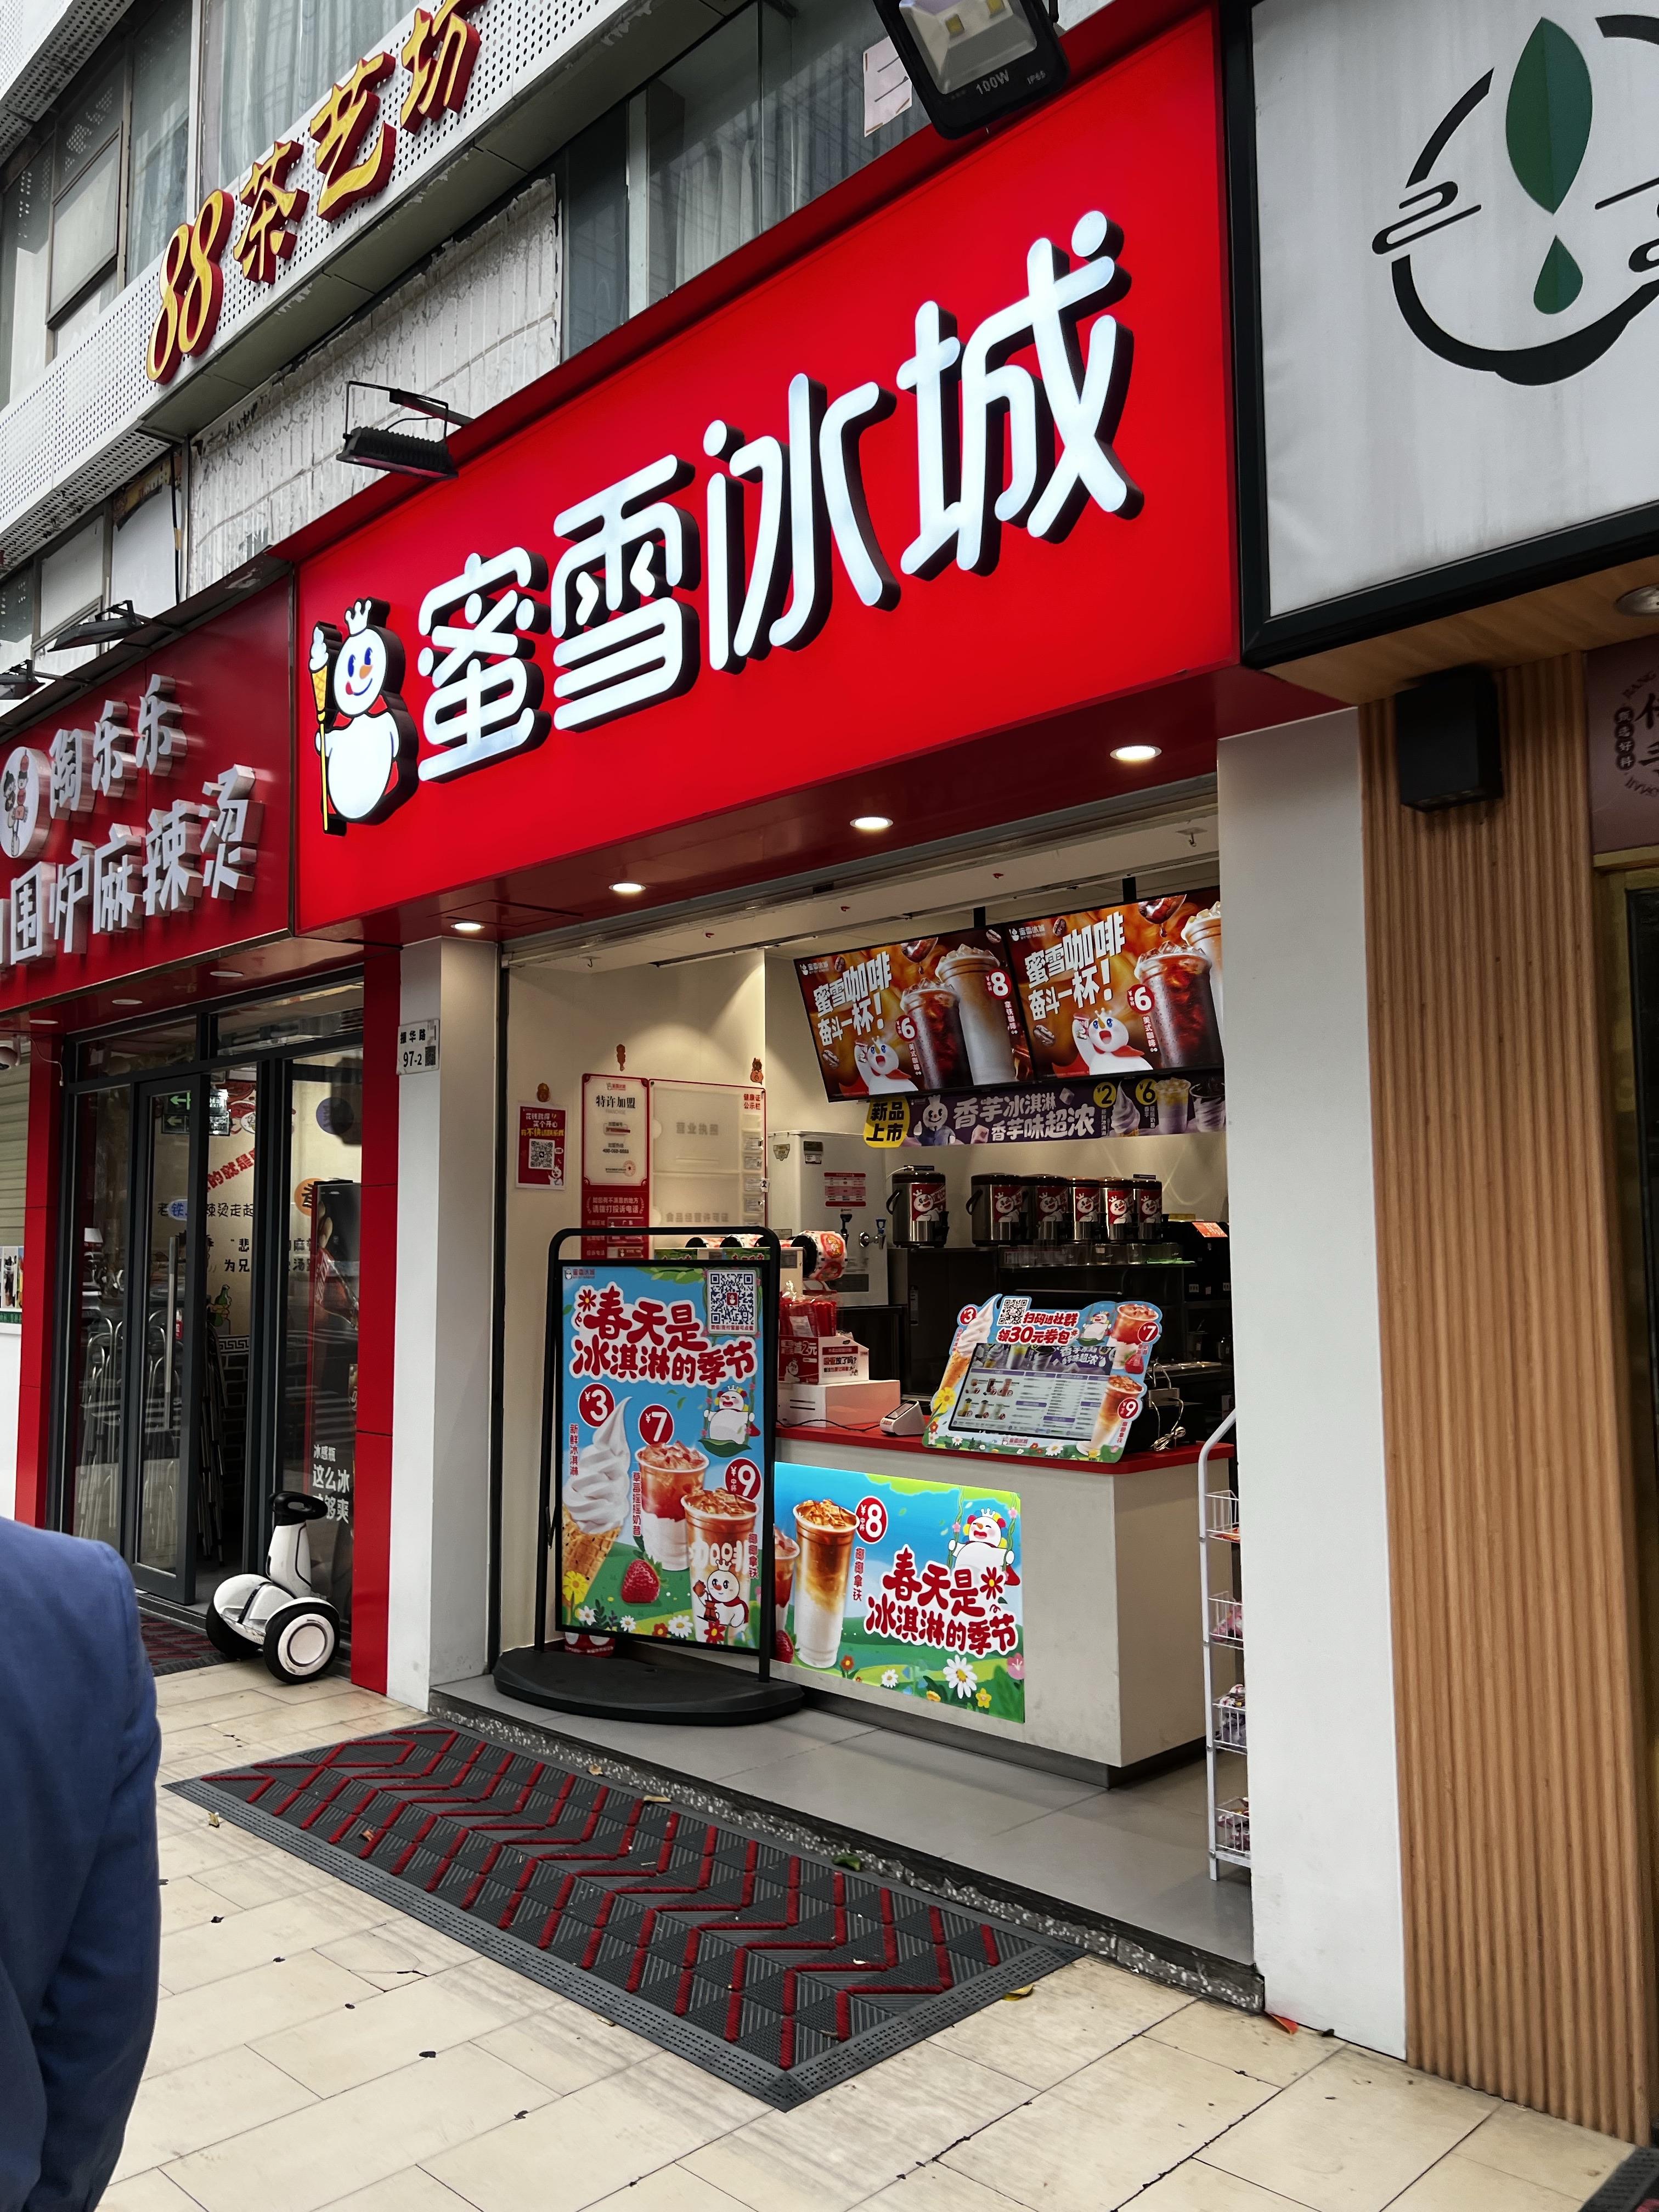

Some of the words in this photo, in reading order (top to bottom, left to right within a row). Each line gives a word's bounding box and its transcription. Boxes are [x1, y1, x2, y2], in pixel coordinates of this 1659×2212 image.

[976, 70, 1009, 94] 100W
[418, 211, 1143, 783] 蜜雪冰城
[0, 764, 263, 968] 围炉麻辣烫
[1025, 912, 1125, 989] 蜜雪咖啡
[814, 951, 891, 1017] 蜜雪咖啡
[1028, 959, 1113, 1021] 奋斗一杯！
[817, 993, 884, 1046] 奋斗一杯！
[404, 1051, 422, 1067] 97-2
[596, 1095, 635, 1108] 特许加盟
[744, 1093, 761, 1102] 健康证
[871, 1101, 904, 1121] 新品
[953, 1093, 1056, 1129] 香芋冰淇淋
[676, 1122, 719, 1136] 营业执照
[866, 1123, 903, 1142] 上市
[991, 1104, 1094, 1141] 香芋味超浓
[207, 1148, 255, 1192] 的就是
[583, 1285, 708, 1352] 春天是
[573, 1334, 755, 1385] 冰淇淋的季节
[585, 1389, 608, 1421] ¥3
[645, 1412, 667, 1442] ¥7
[313, 1444, 336, 1462] 冰感瓶
[569, 1424, 579, 1475] 新鲜冰淇淋
[312, 1464, 350, 1493] 这么冰
[731, 1464, 756, 1497] ¥9
[313, 1493, 349, 1524] 够爽
[861, 1504, 883, 1538] ¥8
[883, 1548, 985, 1617] 春天是
[866, 1594, 1017, 1655] 冰淇淋的季节
